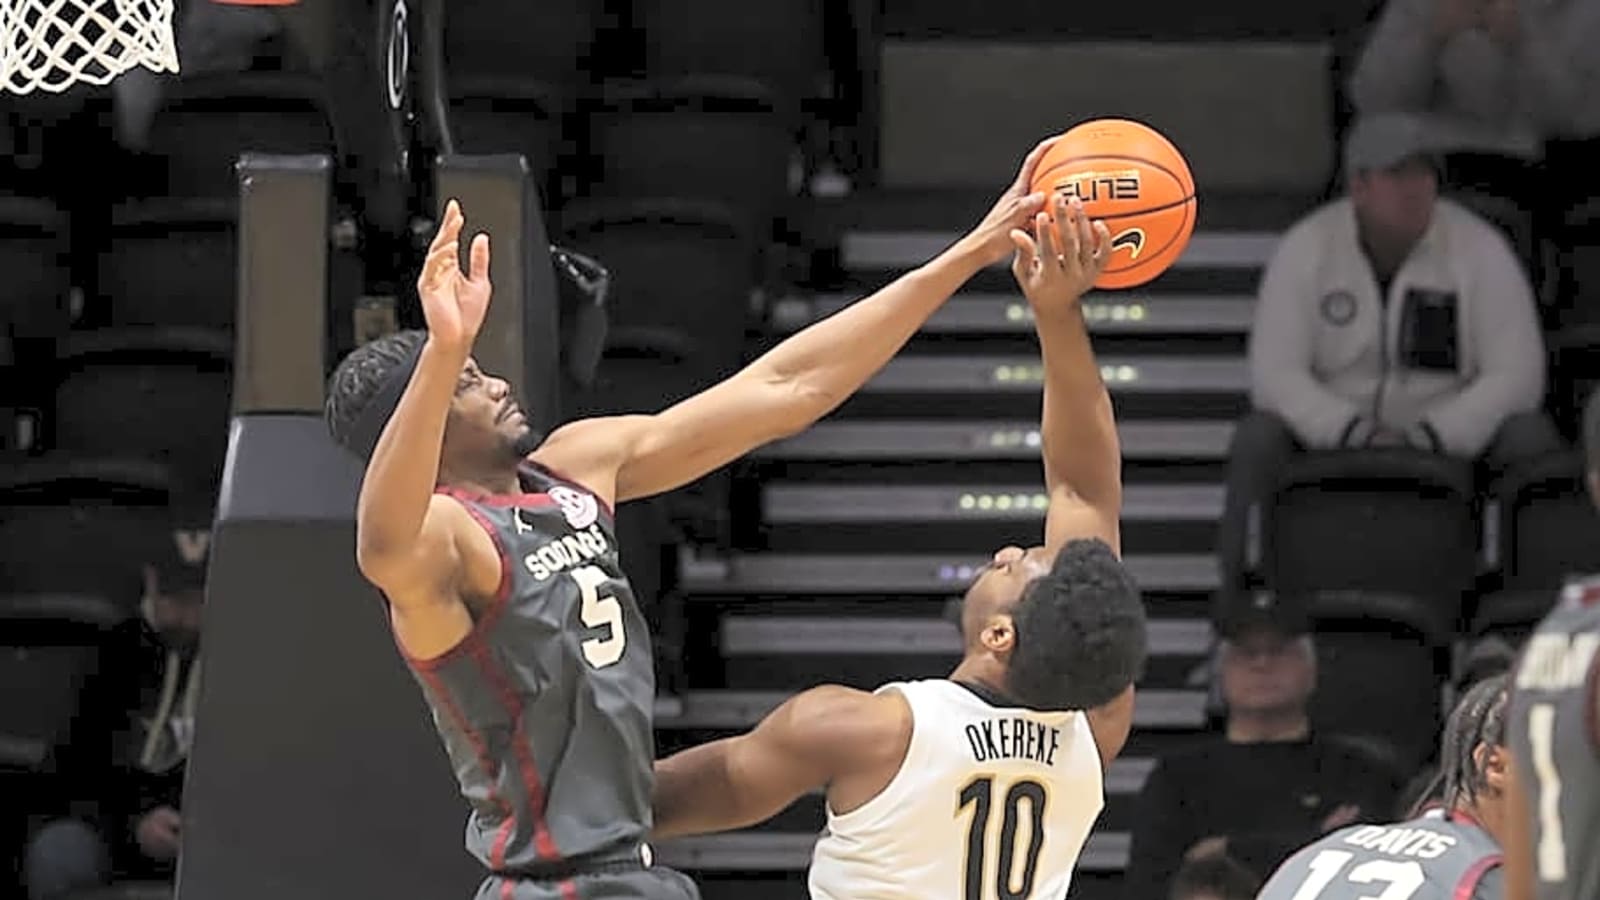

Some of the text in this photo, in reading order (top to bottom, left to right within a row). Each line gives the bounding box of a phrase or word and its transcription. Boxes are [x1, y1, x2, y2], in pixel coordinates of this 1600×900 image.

[570, 564, 627, 669] 5
[965, 717, 1061, 766] OKEREKE
[1529, 703, 1567, 882] 1
[956, 774, 1048, 900] 10
[1344, 825, 1457, 859] DAVIS
